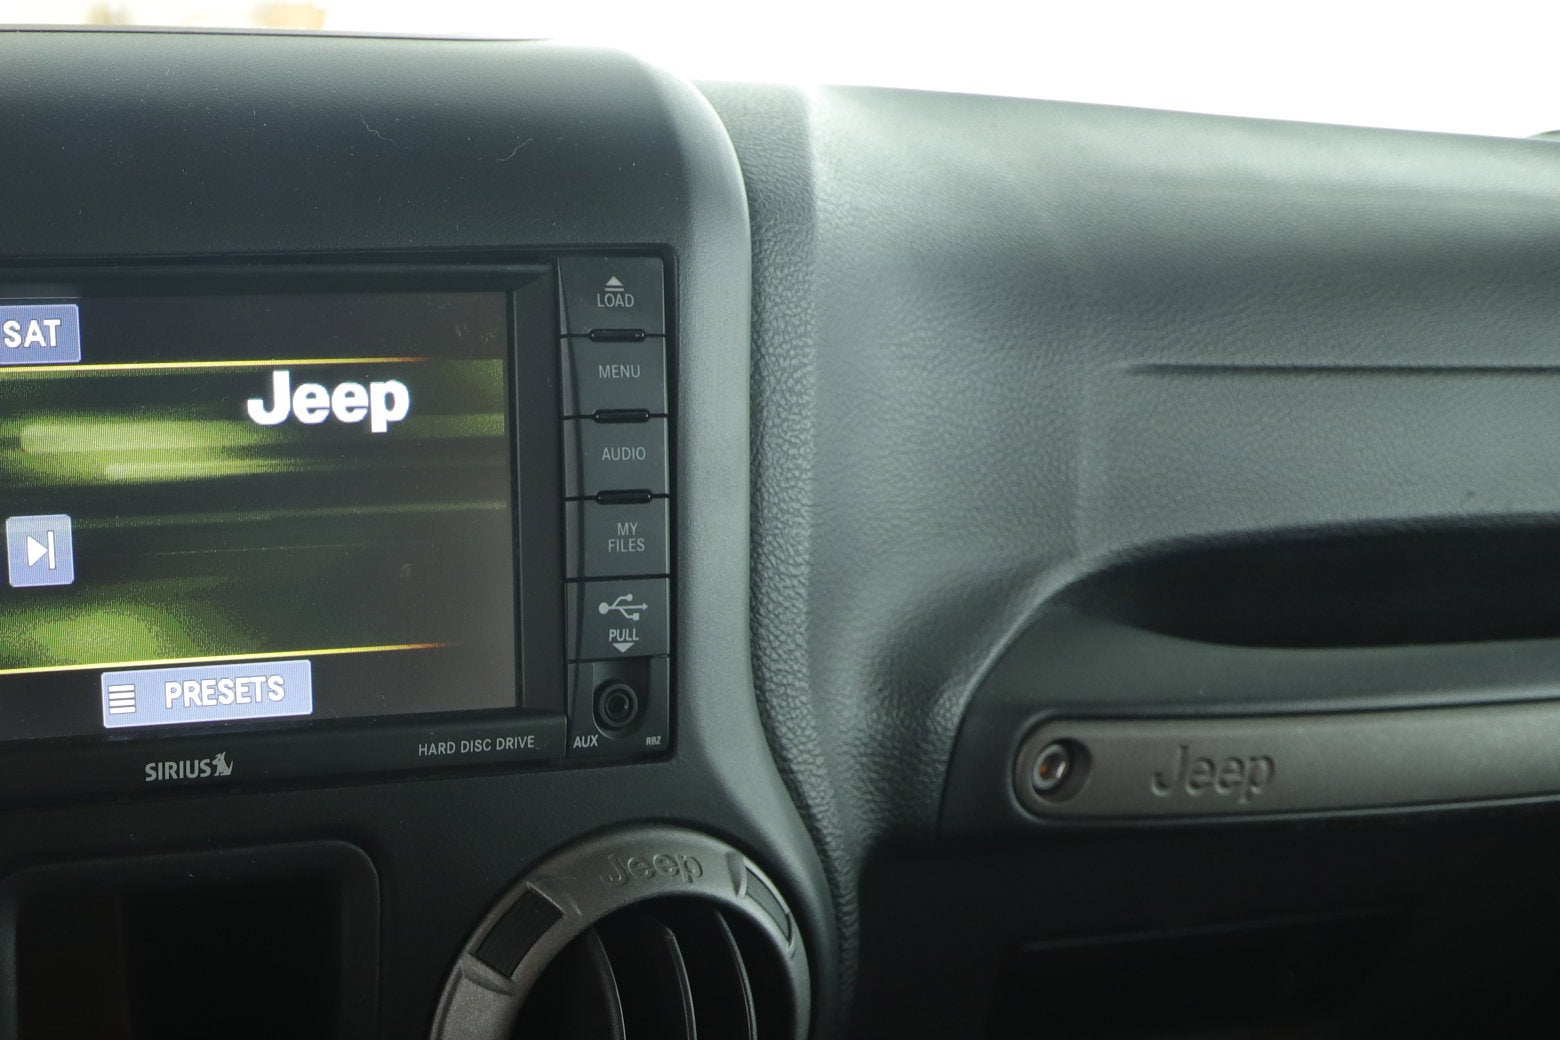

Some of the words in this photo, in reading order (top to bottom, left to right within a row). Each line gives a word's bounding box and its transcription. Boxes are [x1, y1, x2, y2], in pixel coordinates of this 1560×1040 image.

[596, 293, 635, 308] LOAD
[2, 318, 62, 349] SAT
[598, 363, 641, 380] MENU
[246, 370, 410, 433] Jeep
[602, 445, 647, 462] AUDIO
[616, 521, 638, 537] MY
[607, 536, 646, 553] FILES
[608, 628, 640, 643] PULL
[164, 674, 286, 710] PRESETS
[418, 741, 456, 757] HARD
[460, 738, 493, 754] DISC
[496, 735, 536, 750] DRIVE
[573, 734, 599, 749] AUX
[144, 758, 212, 783] SIRIUS
[1150, 744, 1277, 805] Jeep
[600, 853, 704, 886] Jeep
